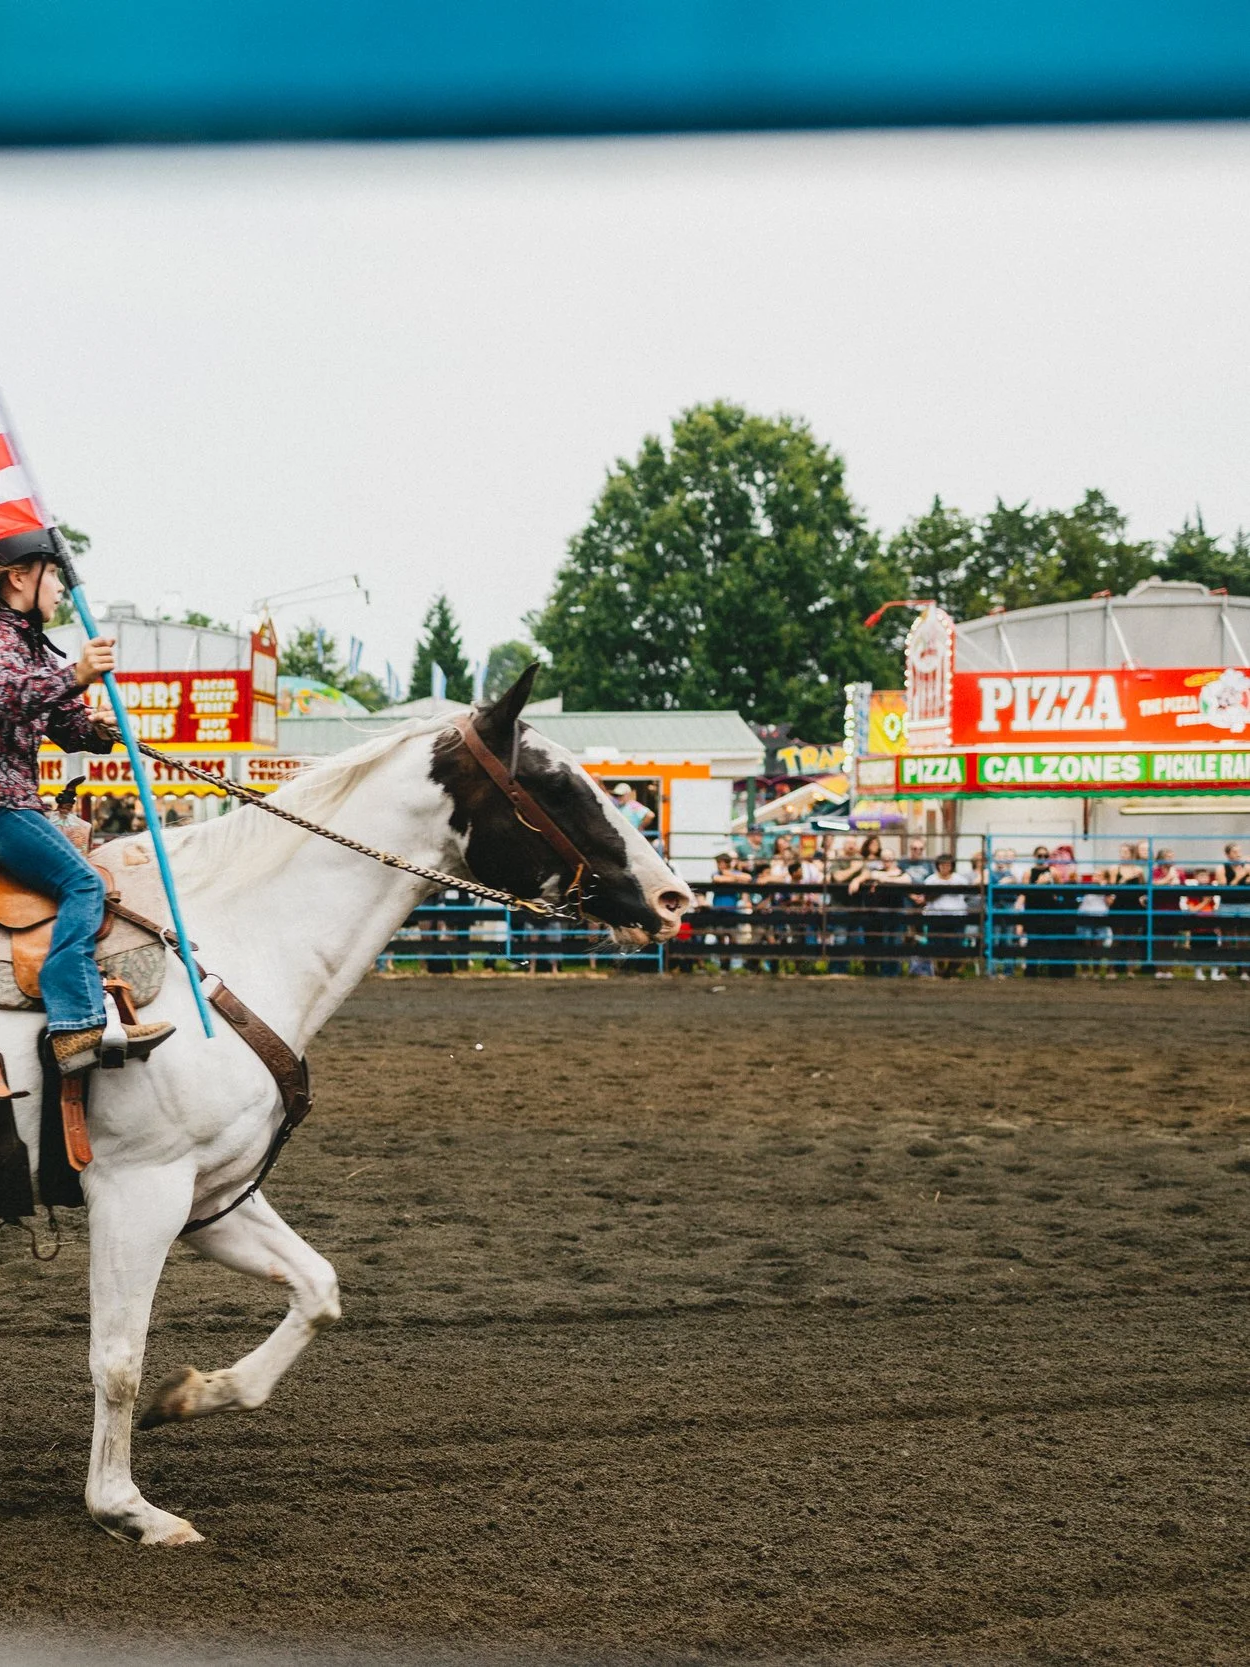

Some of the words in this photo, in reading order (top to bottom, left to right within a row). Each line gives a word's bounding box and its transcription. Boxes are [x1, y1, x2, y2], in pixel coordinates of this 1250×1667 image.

[192, 679, 236, 691] BACON
[976, 675, 1127, 733] PIZZA
[127, 713, 176, 741] RIES
[40, 760, 62, 780] IES
[88, 761, 146, 781] MOZ
[248, 760, 304, 770] CHICKE
[903, 757, 962, 784] PIZZA
[984, 755, 1141, 783] CALZONES
[1154, 754, 1216, 780] PICKLE
